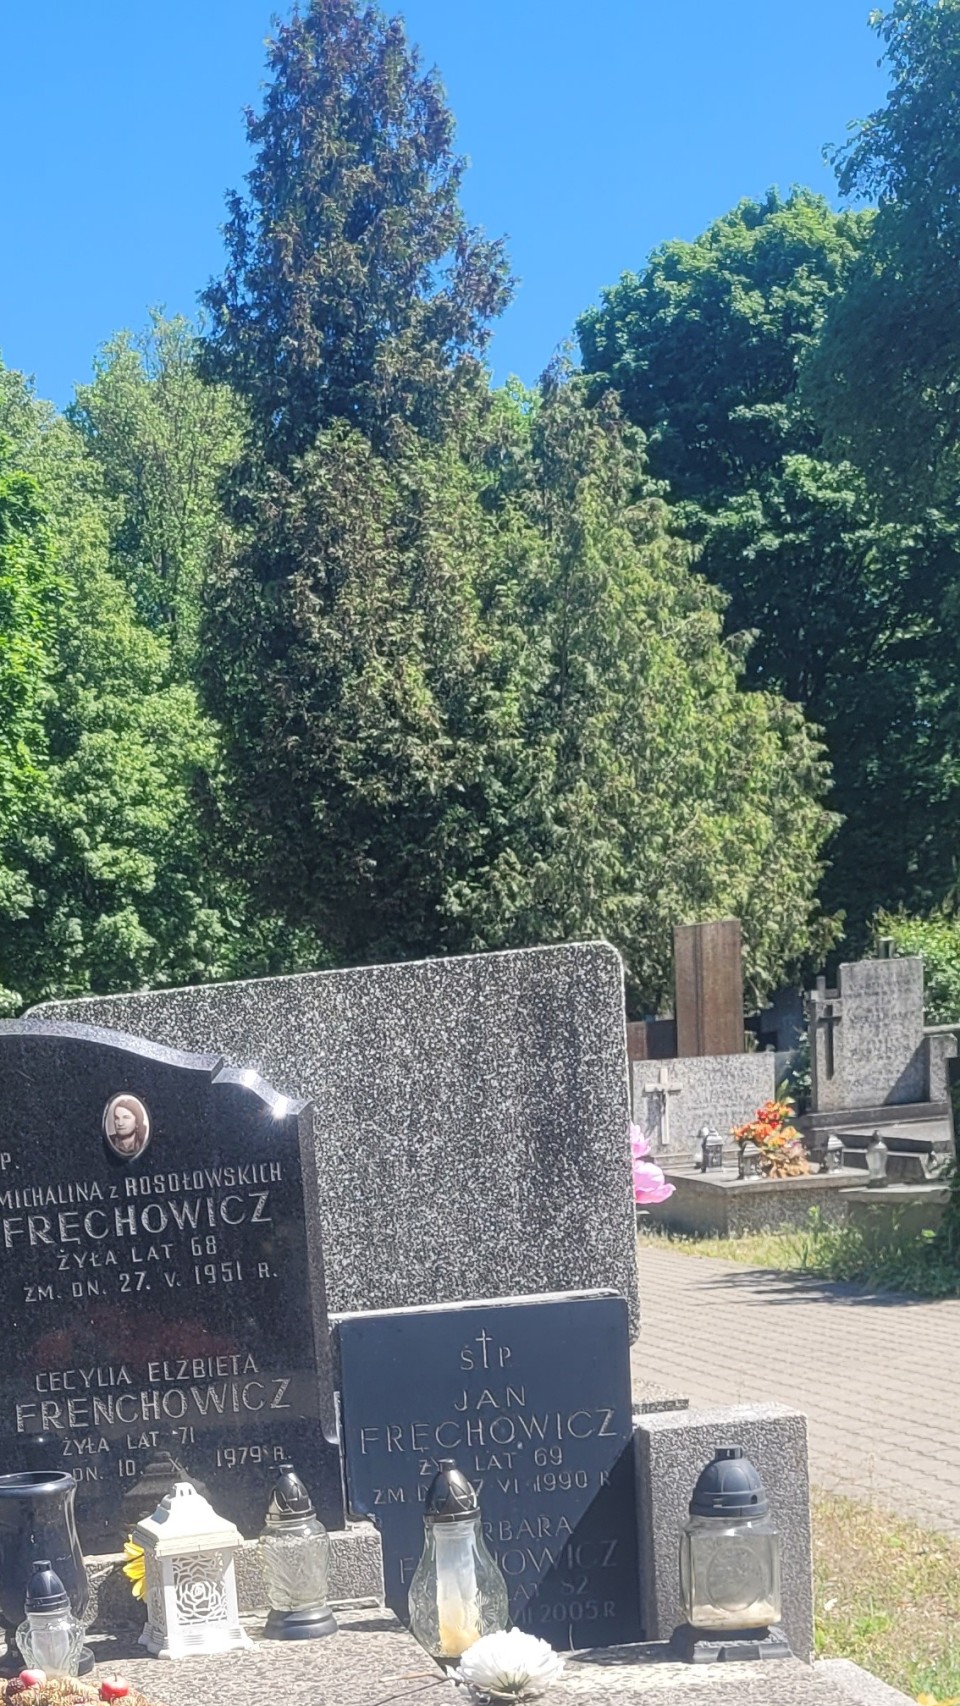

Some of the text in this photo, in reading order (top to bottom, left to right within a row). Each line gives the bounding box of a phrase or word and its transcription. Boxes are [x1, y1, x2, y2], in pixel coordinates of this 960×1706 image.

[125, 1161, 283, 1196] ROSOŁOWSKICH
[3, 1190, 273, 1249] FRĘCHOWICZ
[57, 1235, 217, 1271] ŻYŁA LAT 68
[24, 1284, 62, 1302] ZM.
[120, 1271, 151, 1293] 27.
[195, 1259, 242, 1285] 1951
[35, 1353, 259, 1393] CECYLIA ELŻBIETA
[499, 1346, 512, 1368] P
[16, 1378, 291, 1433] FRENCHOWICZ
[454, 1385, 526, 1411] JAN
[62, 1437, 110, 1456] ŻYŁA
[127, 1431, 159, 1450] LAT
[361, 1408, 617, 1455] FRĘCHOWICZ
[216, 1445, 262, 1468] 1979
[475, 1452, 517, 1472] LAT
[534, 1446, 563, 1467] 69
[373, 1487, 405, 1505] ZM
[497, 1478, 519, 1495] VI
[534, 1470, 588, 1493] 1990
[600, 1470, 611, 1487] R
[483, 1515, 574, 1543] RBARA
